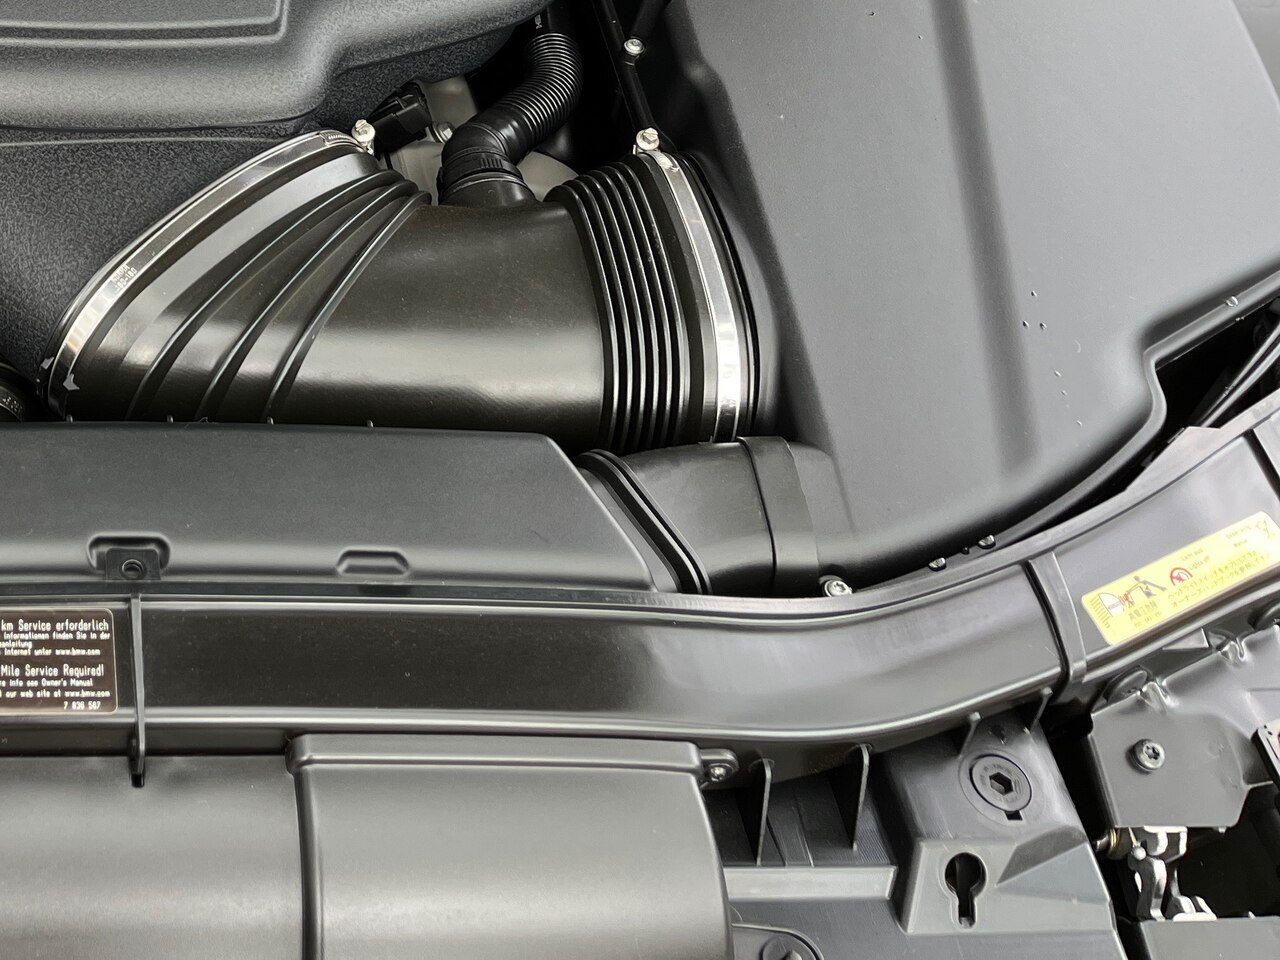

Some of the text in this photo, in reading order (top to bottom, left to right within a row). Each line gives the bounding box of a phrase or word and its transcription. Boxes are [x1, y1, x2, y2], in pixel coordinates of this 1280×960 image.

[1, 619, 14, 631] km
[19, 619, 51, 631] Service
[56, 619, 109, 631] erforderlich
[4, 632, 49, 640] Informationen
[53, 631, 73, 640] finden
[76, 631, 87, 640] Sie
[5, 648, 31, 656] Internet
[34, 647, 51, 656] unter
[55, 647, 100, 656] www.bmw.com
[1, 664, 20, 677] Mile
[25, 664, 58, 677] Service
[63, 663, 104, 678] Required!
[10, 678, 23, 687] info
[41, 678, 67, 687] Owner's
[70, 678, 93, 686] Manual
[20, 689, 33, 698] web
[36, 689, 50, 698] site
[54, 689, 61, 698] at
[65, 689, 110, 698] www.bmw.com
